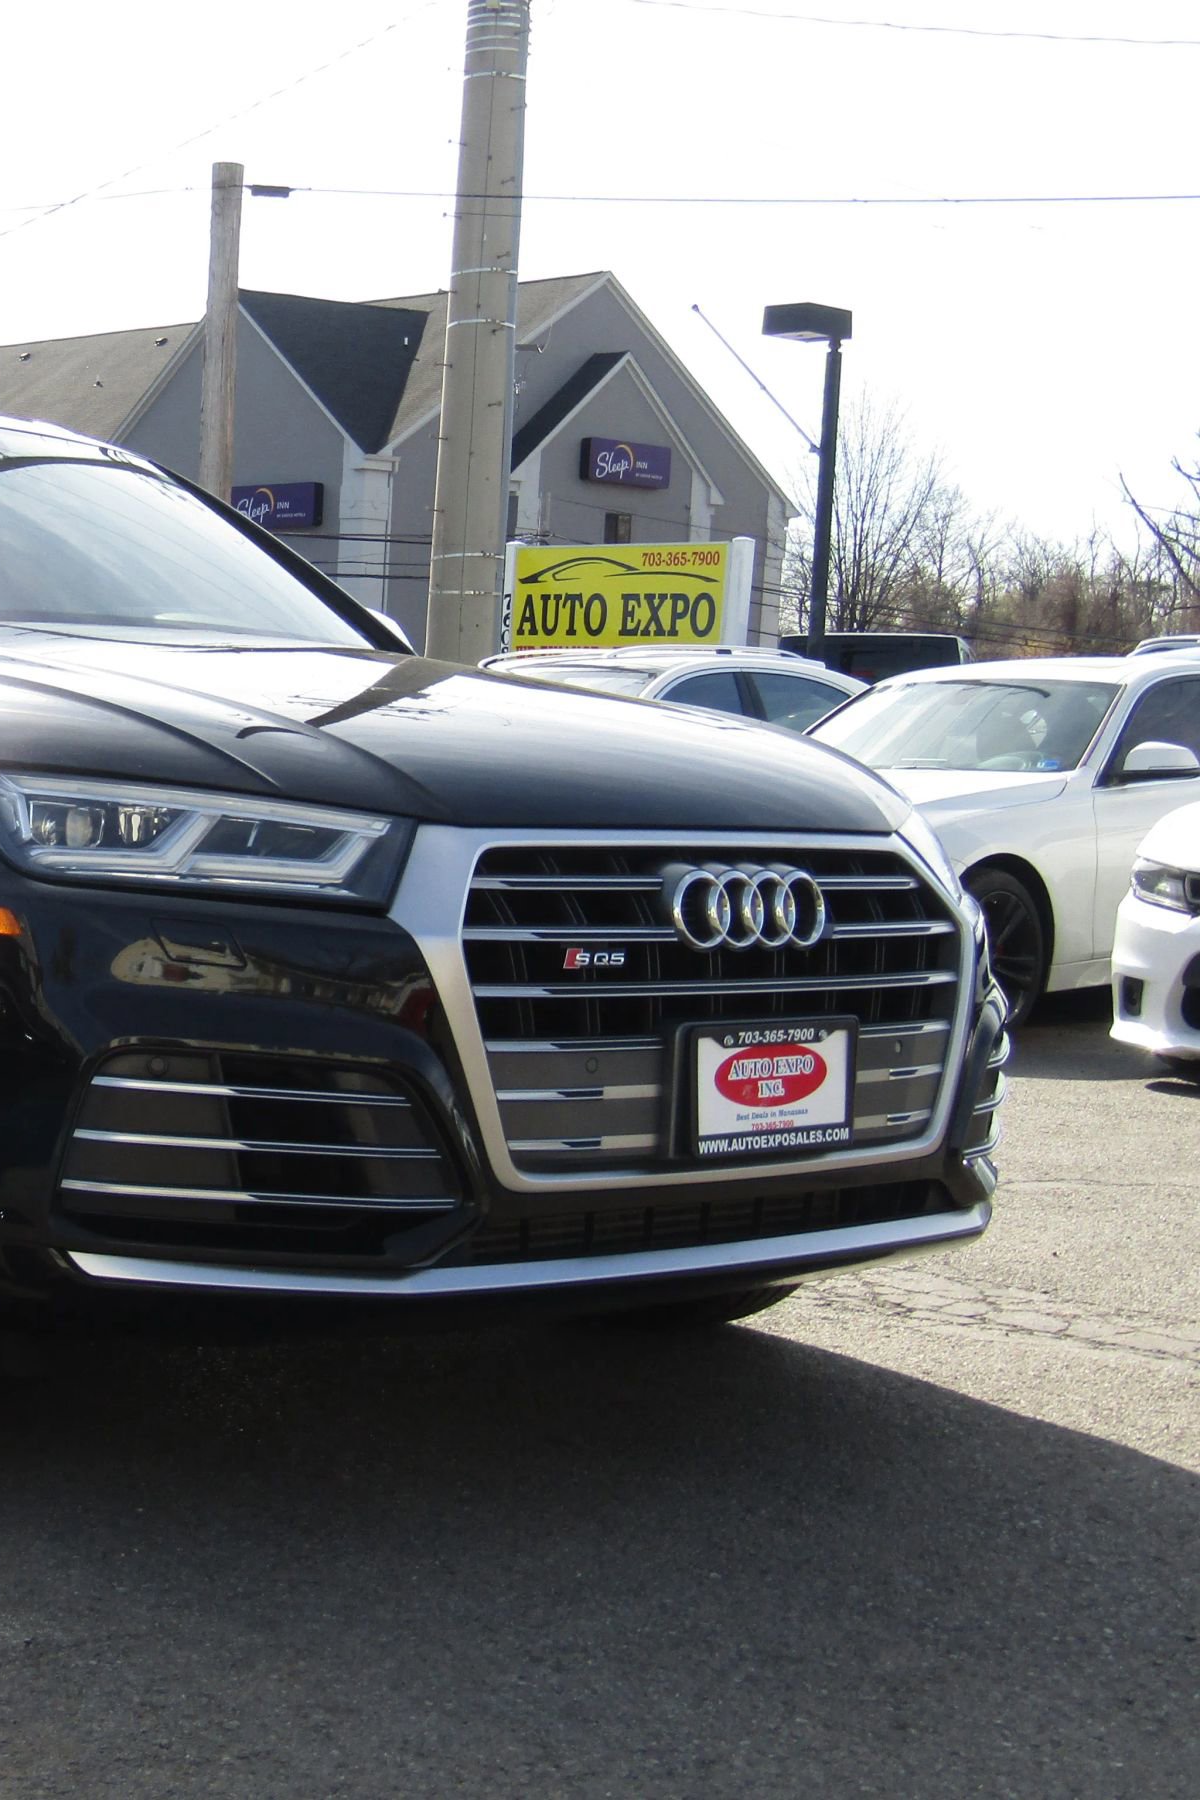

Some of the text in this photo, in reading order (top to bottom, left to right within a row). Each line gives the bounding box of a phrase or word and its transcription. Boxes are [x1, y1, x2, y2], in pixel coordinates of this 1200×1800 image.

[596, 452, 648, 479] Sleep INN
[237, 497, 290, 523] Sleep INN
[641, 551, 720, 567] 703-365-7900
[516, 592, 716, 638] AUTO EXPO
[574, 952, 625, 967] SQ5
[738, 1028, 814, 1044] 703-365-7900
[728, 1054, 814, 1081] AUTO EXPO
[758, 1079, 785, 1098] INC.
[736, 1113, 750, 1121] Best
[751, 1111, 769, 1120] Deals
[698, 1127, 849, 1154] WWW.AUTOEXPOSALES.COM
